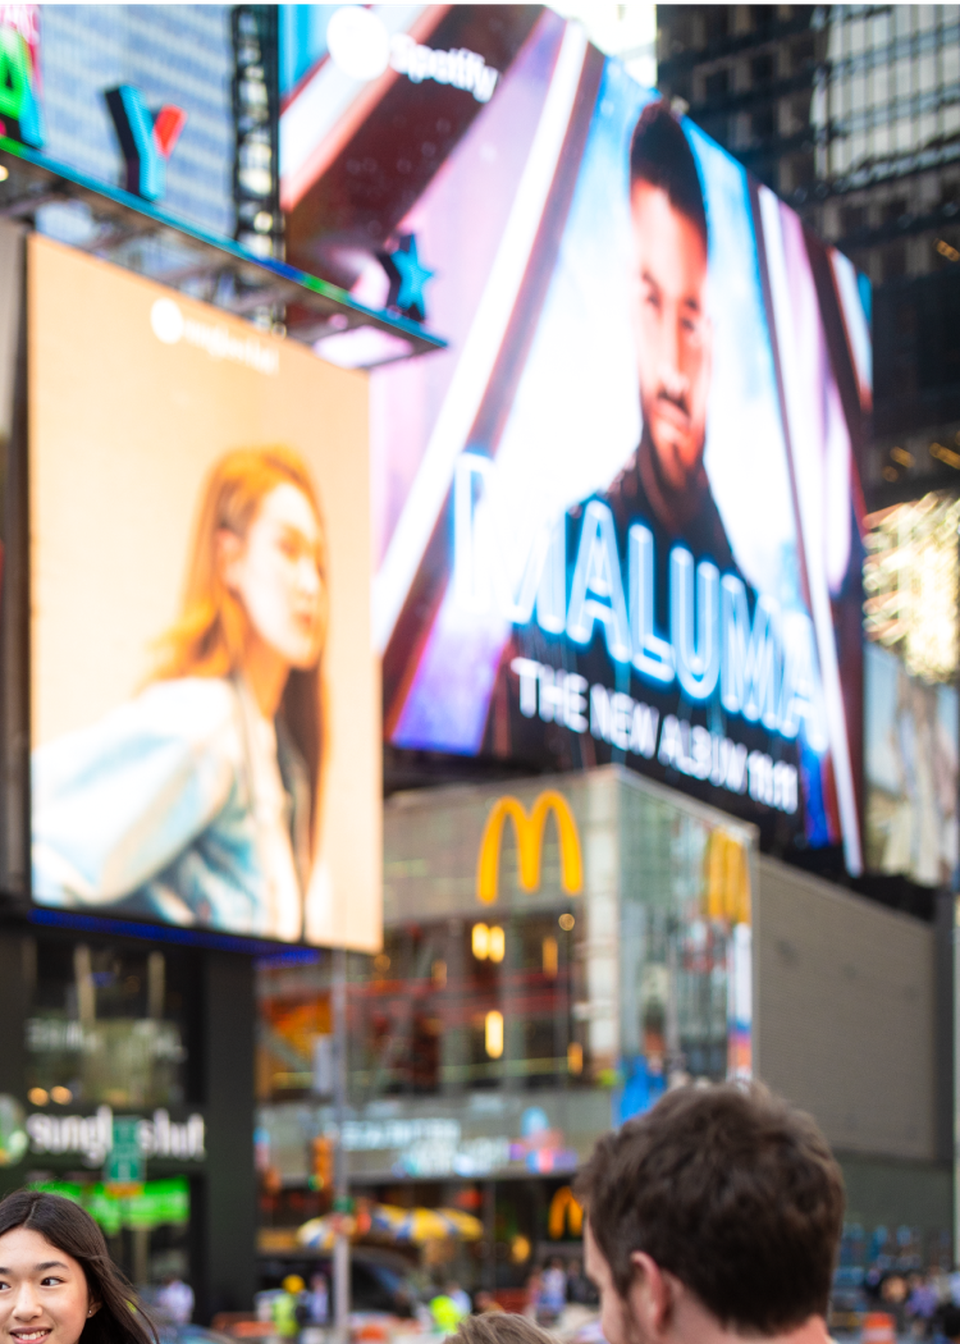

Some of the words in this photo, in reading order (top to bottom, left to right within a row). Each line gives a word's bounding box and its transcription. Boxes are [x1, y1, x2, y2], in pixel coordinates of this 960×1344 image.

[390, 33, 498, 103] Spotify
[511, 656, 588, 734] THE
[590, 683, 660, 760] NEW
